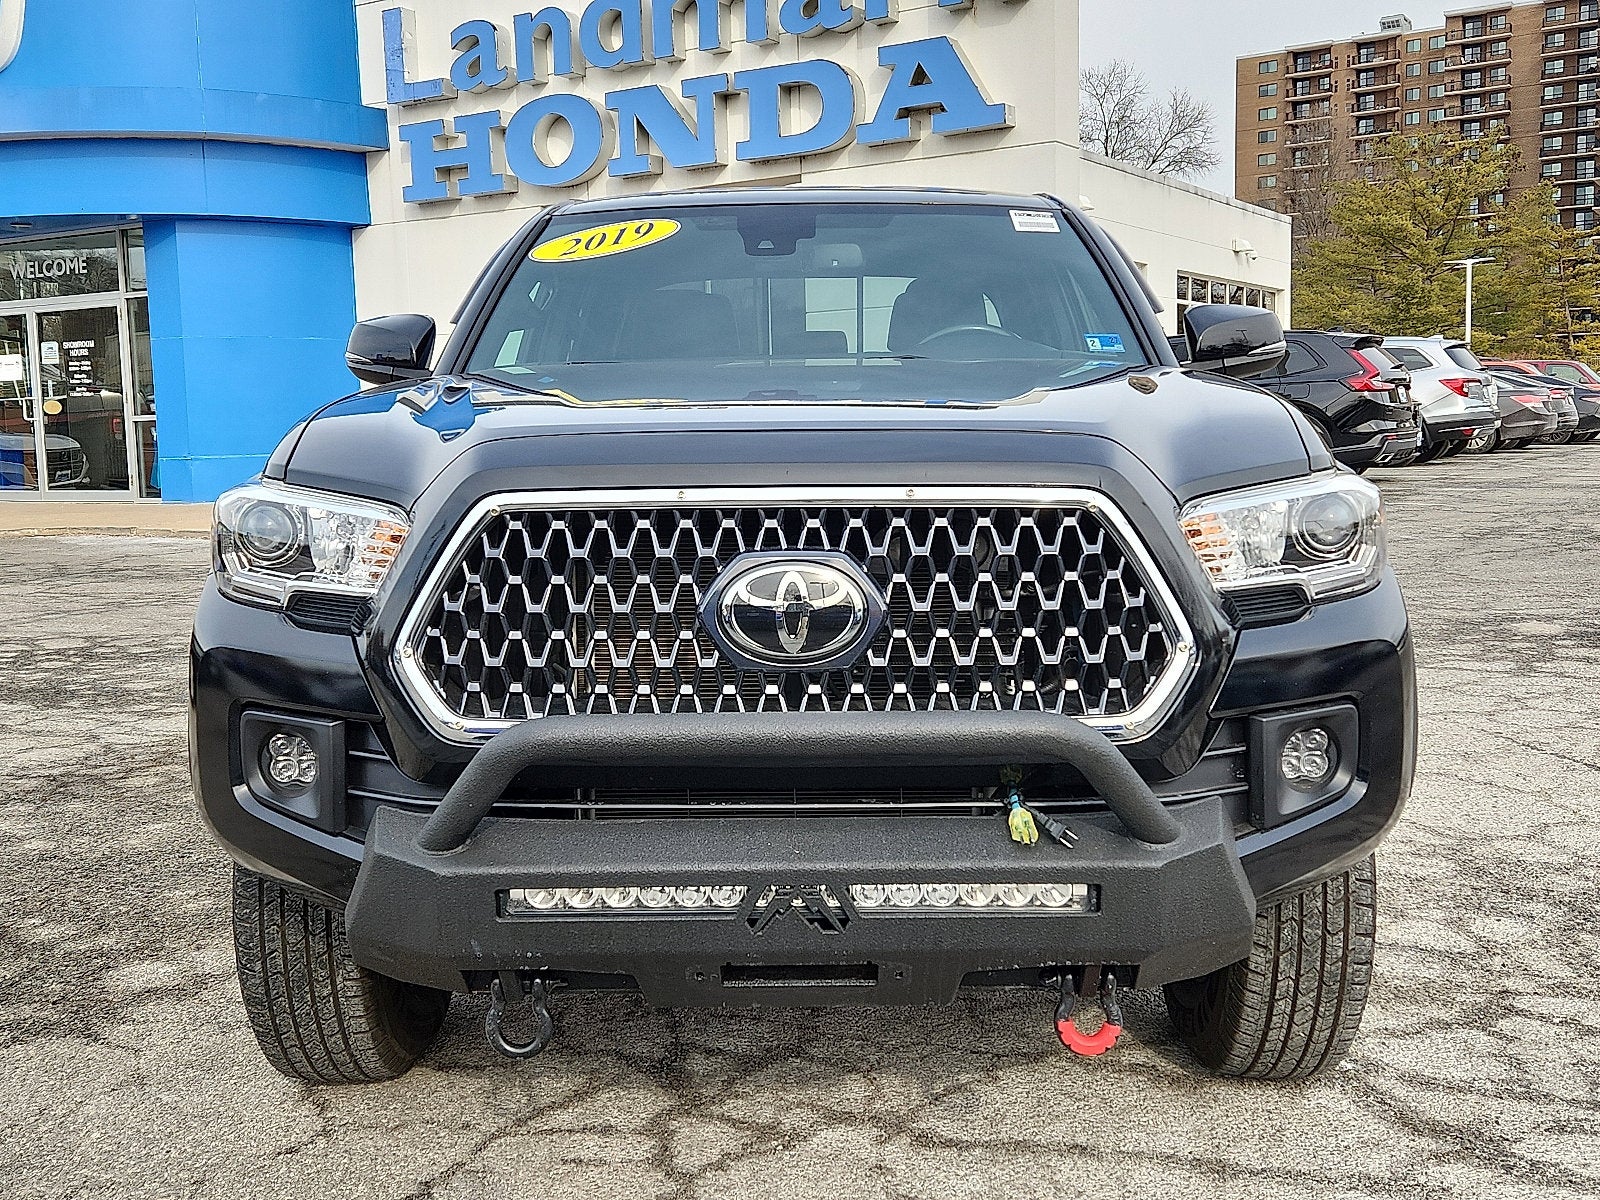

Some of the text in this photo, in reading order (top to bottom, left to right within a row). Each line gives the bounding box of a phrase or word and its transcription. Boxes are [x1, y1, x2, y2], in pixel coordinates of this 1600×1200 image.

[383, 0, 974, 105] Landma
[399, 36, 1010, 204] HONDA
[9, 256, 88, 280] WELCOME
[558, 221, 654, 258] 2019
